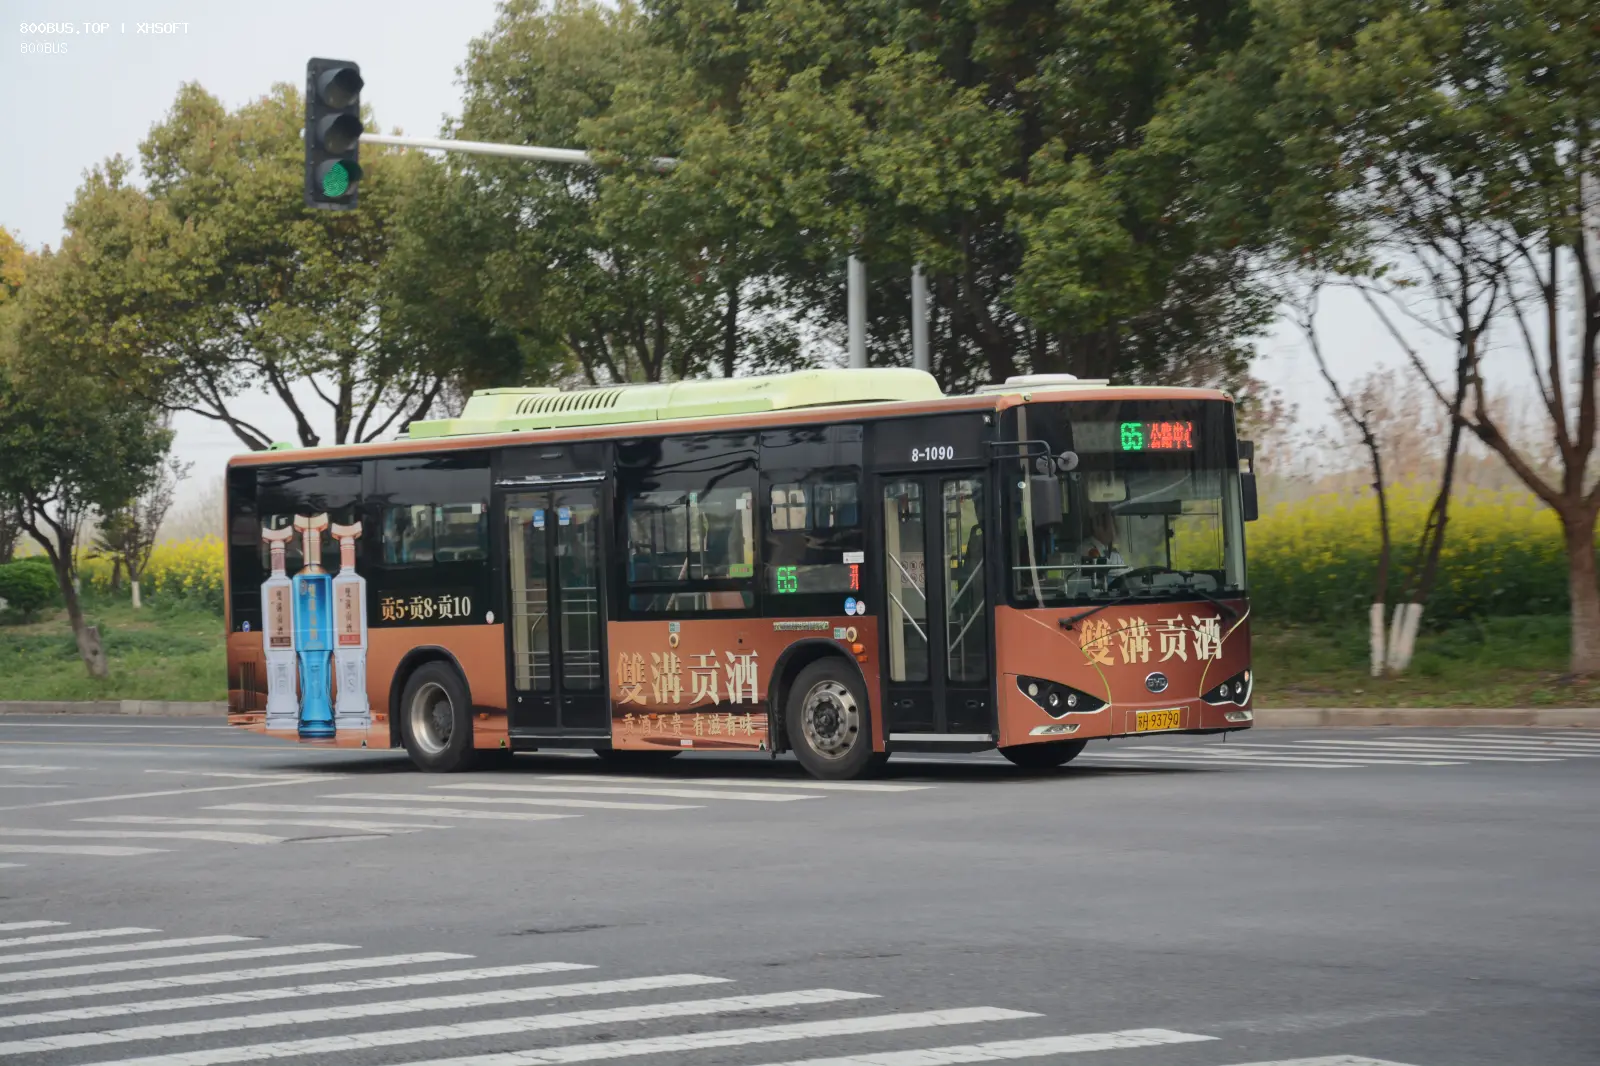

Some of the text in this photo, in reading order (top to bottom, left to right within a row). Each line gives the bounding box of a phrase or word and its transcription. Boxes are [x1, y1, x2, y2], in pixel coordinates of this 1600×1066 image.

[1120, 422, 1143, 450] 65
[911, 445, 954, 462] 8-1090
[776, 565, 798, 593] 65
